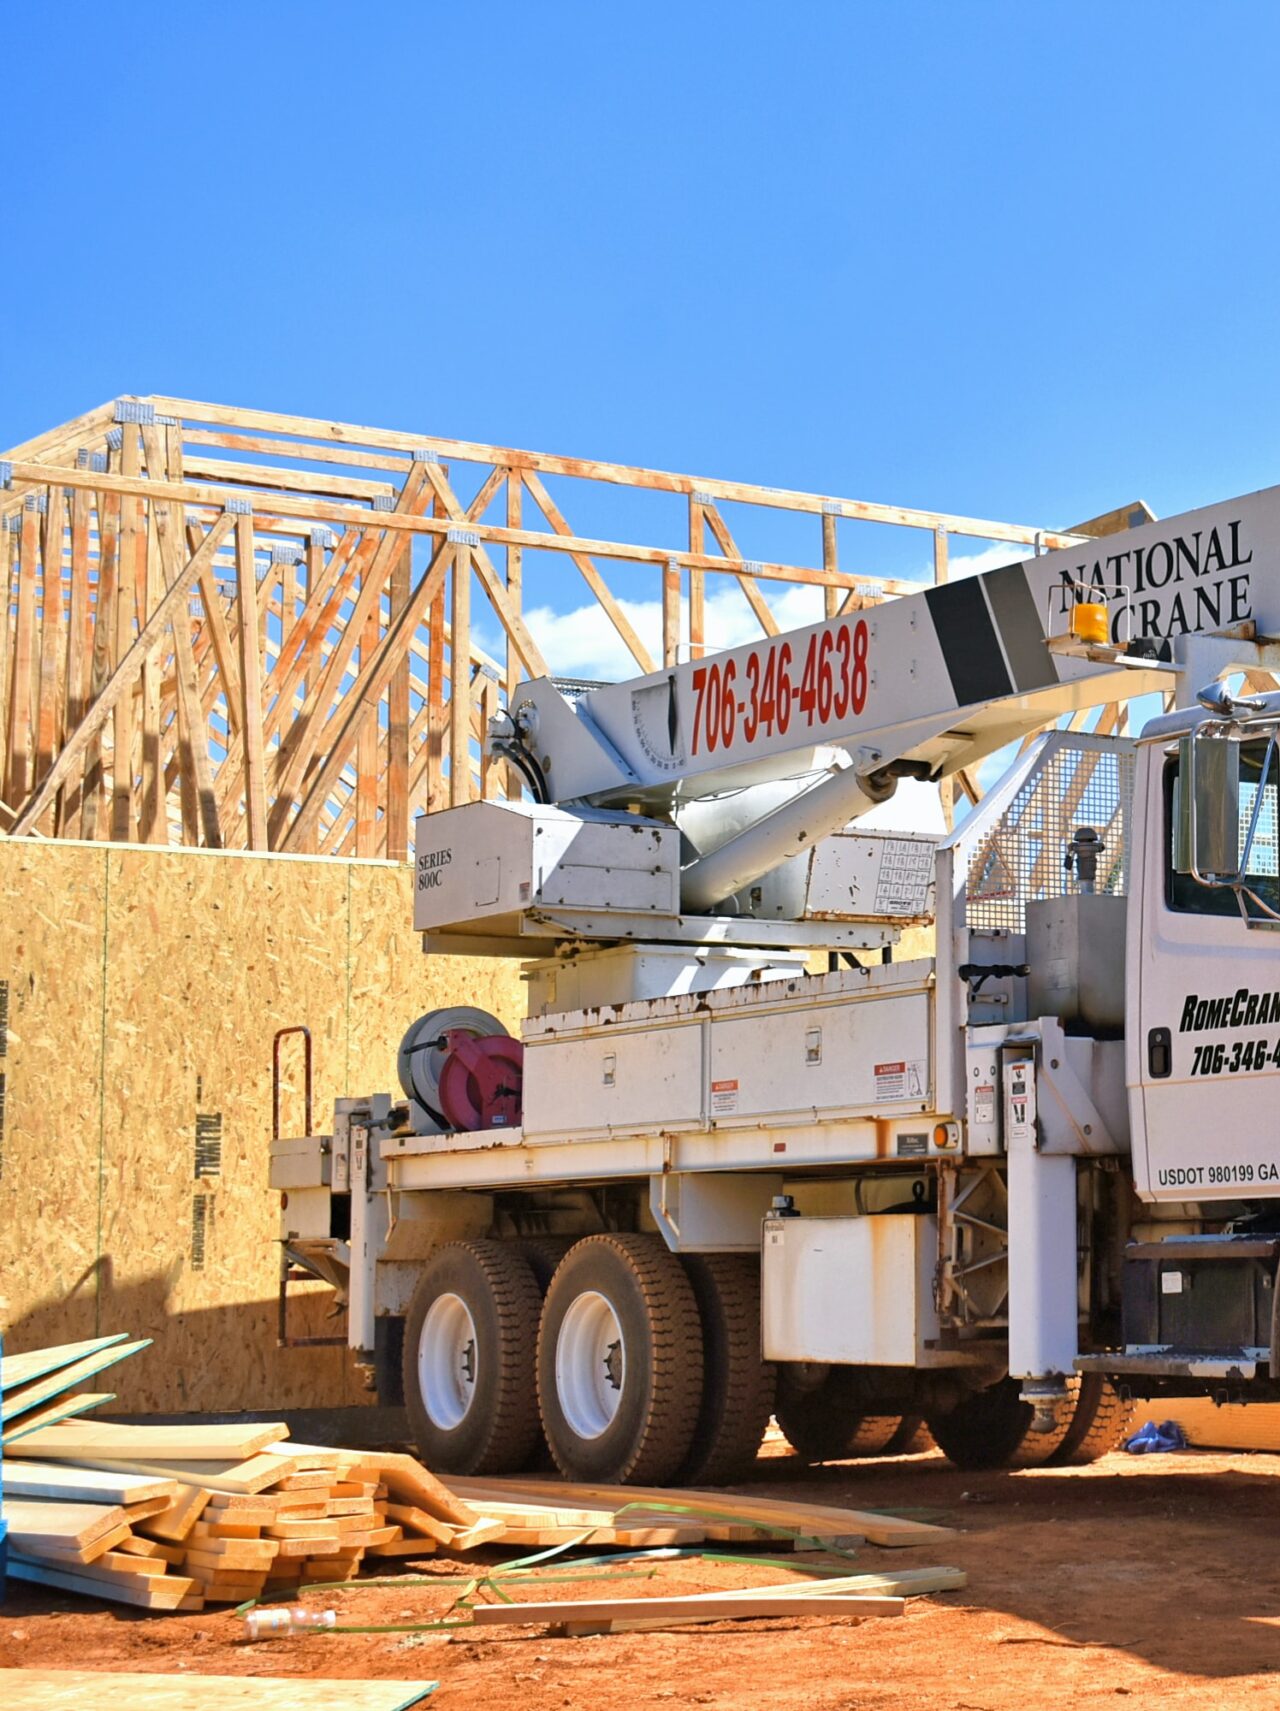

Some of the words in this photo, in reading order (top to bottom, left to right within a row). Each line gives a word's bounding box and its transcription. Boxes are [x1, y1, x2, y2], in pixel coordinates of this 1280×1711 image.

[1059, 520, 1253, 614] NATIONAL
[1111, 574, 1252, 645] CRANE
[692, 619, 868, 756] 706-346-4638
[418, 848, 452, 872] SERIES
[418, 869, 442, 891] 800C
[1158, 1167, 1204, 1186] USDOT
[1208, 1164, 1254, 1183] 980199
[1258, 1163, 1279, 1180] GA
